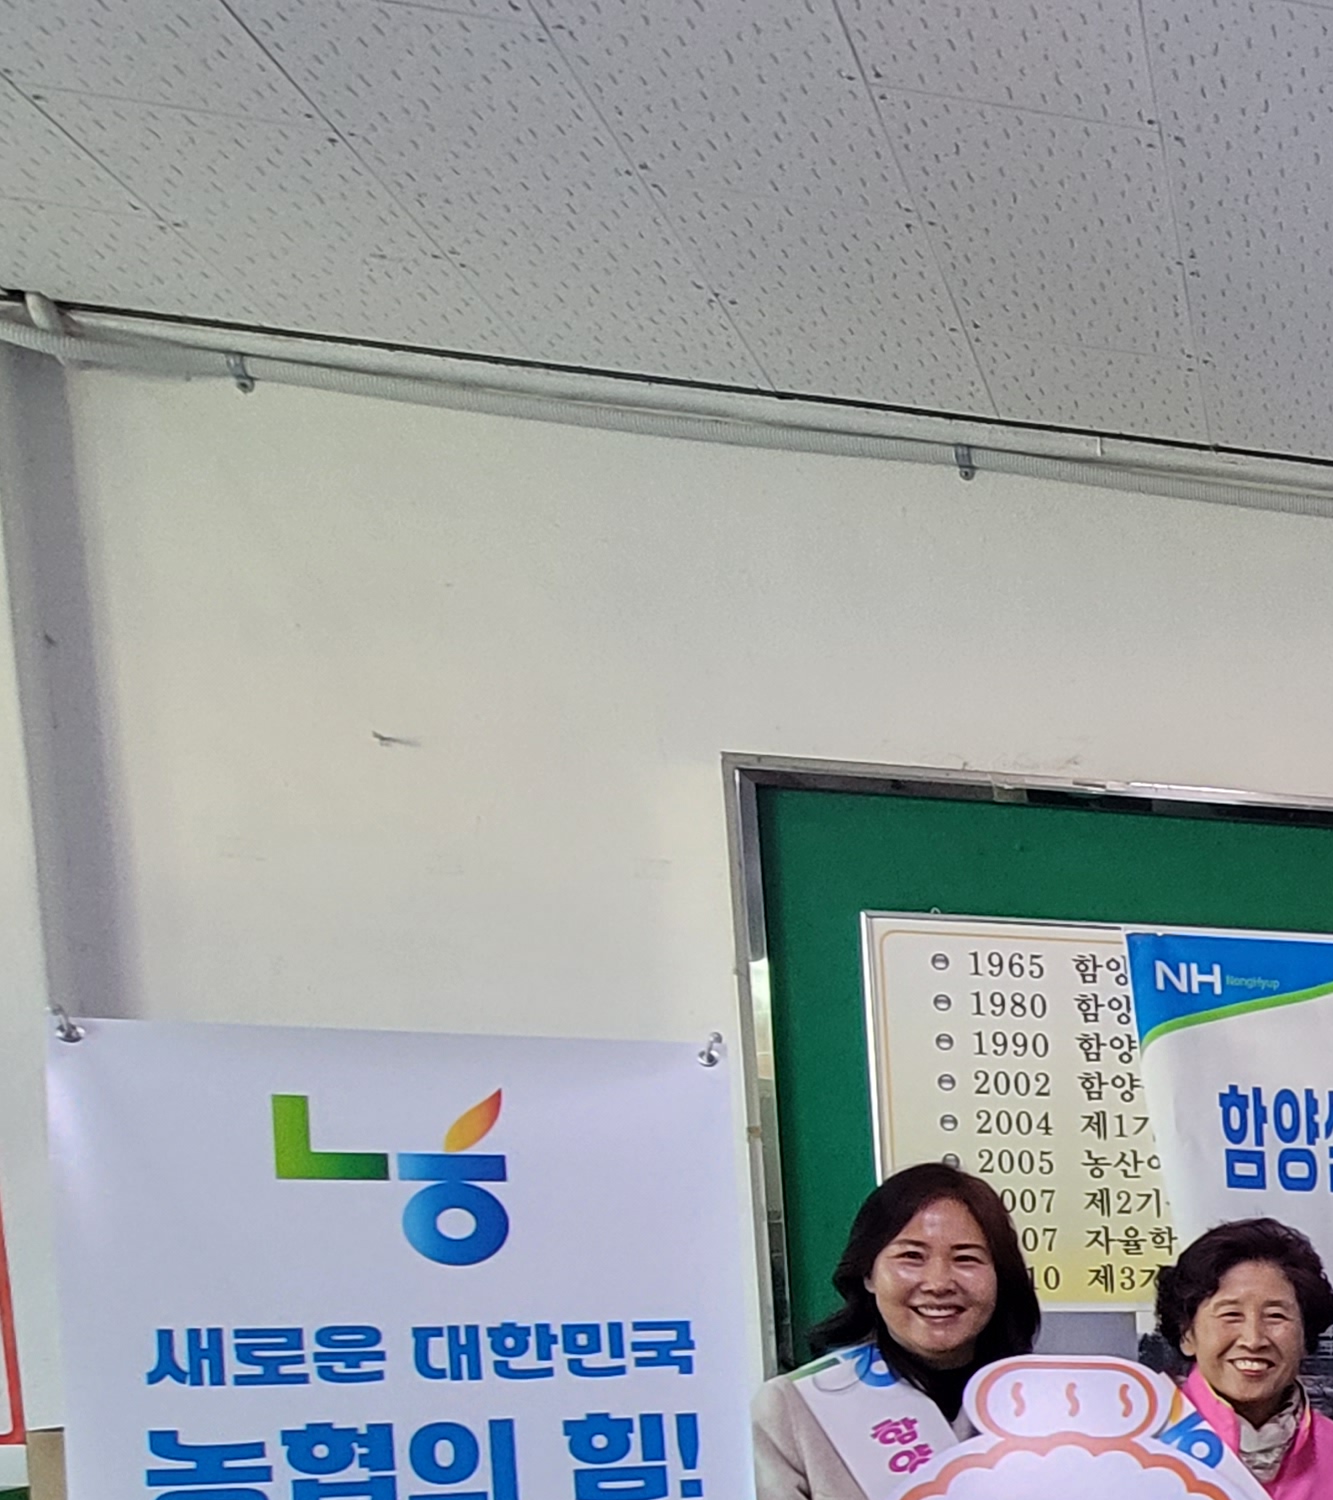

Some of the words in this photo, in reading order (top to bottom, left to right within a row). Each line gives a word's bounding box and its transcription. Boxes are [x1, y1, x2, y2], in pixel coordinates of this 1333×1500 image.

[968, 951, 1044, 979] 1965
[1154, 960, 1222, 995] NH
[970, 991, 1047, 1019] 1980
[972, 1030, 1049, 1058] 1990
[1075, 1032, 1137, 1065] 함양
[974, 1069, 1051, 1097] 2002
[976, 1109, 1053, 1136] 2004
[978, 1149, 1054, 1175] 2005
[1000, 1188, 1056, 1214] 007
[1022, 1227, 1058, 1252] 07
[1028, 1266, 1060, 1291] 10
[147, 1324, 386, 1387] 새로운
[412, 1319, 696, 1381] 대한민국
[870, 1416, 934, 1474] 함양
